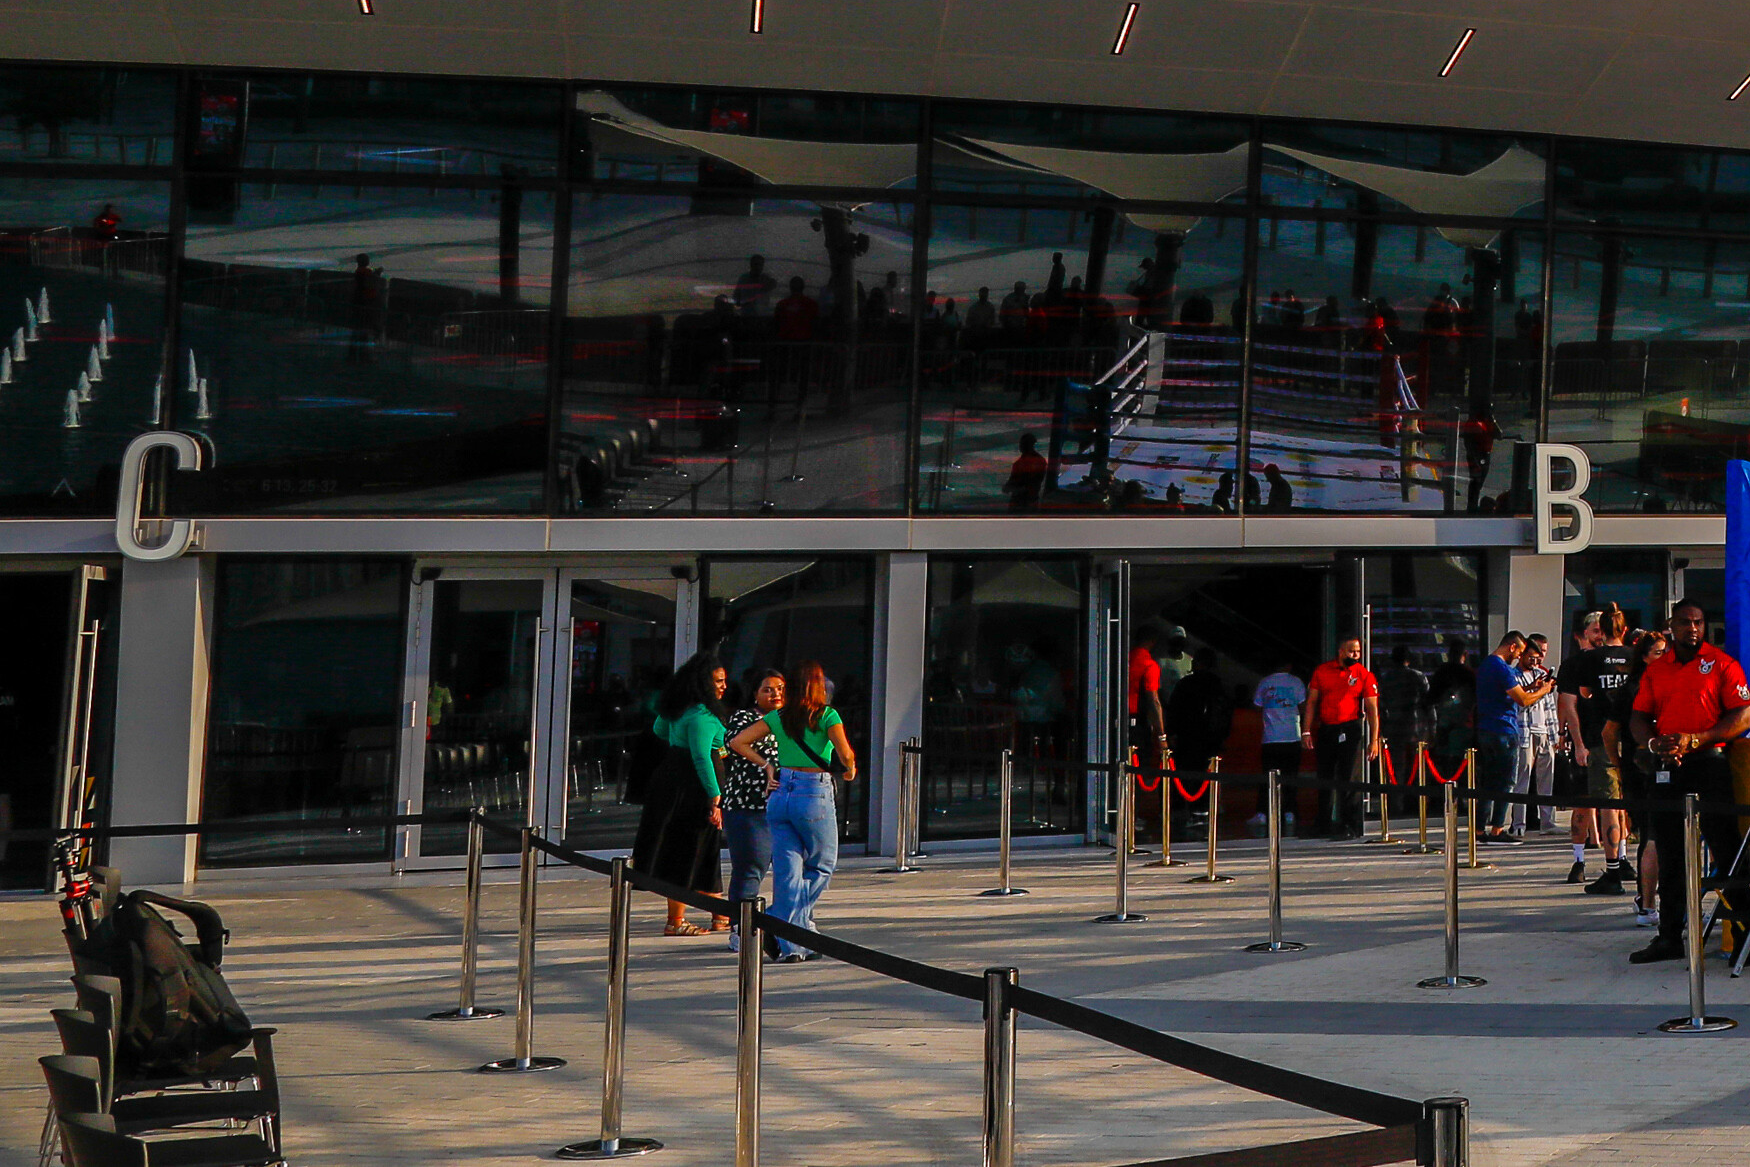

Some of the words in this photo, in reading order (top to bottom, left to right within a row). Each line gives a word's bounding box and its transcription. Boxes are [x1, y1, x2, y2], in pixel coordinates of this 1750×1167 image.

[116, 431, 202, 561] C
[1536, 443, 1594, 554] B
[1598, 674, 1629, 689] TEA
